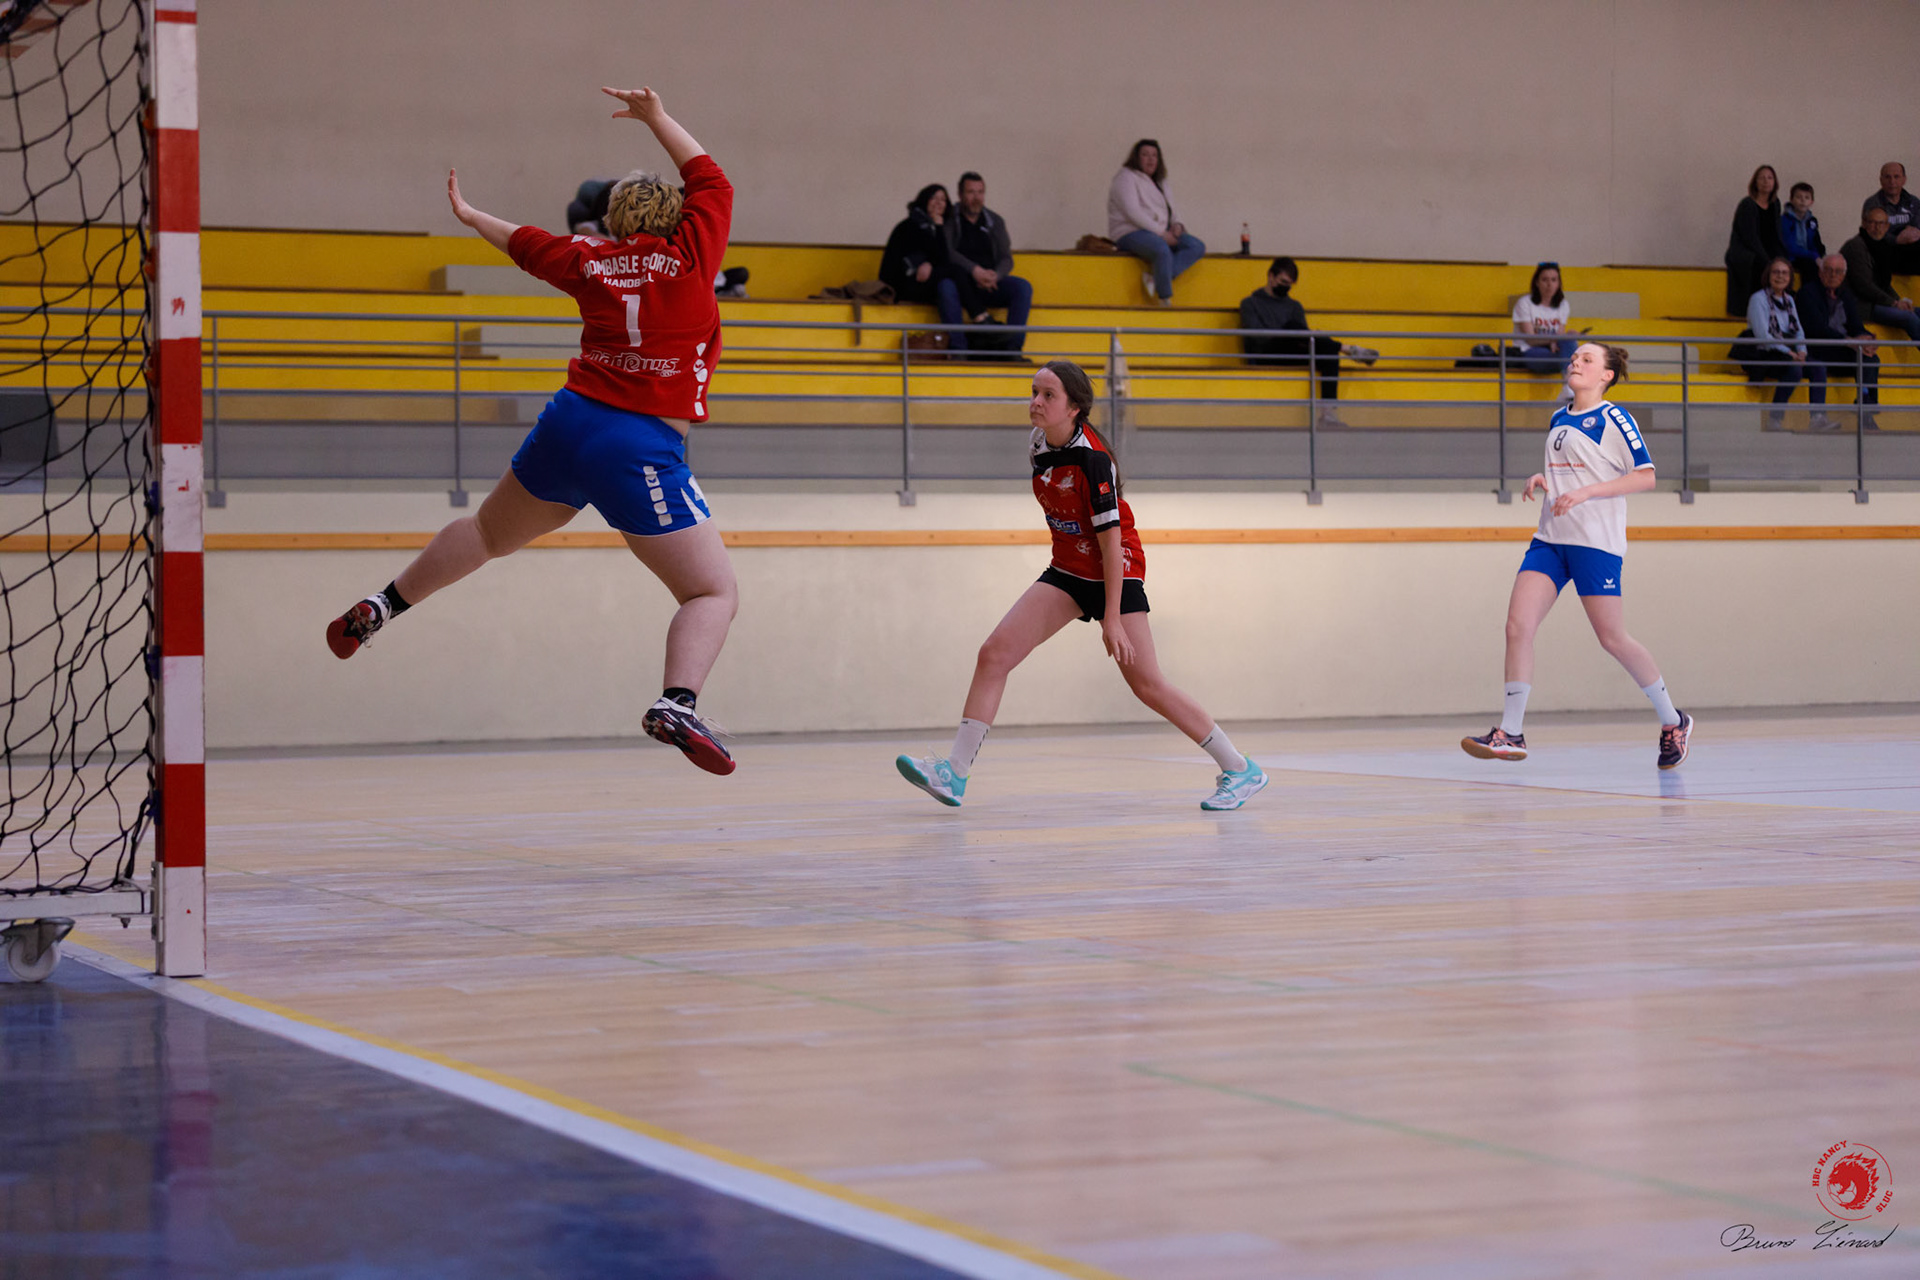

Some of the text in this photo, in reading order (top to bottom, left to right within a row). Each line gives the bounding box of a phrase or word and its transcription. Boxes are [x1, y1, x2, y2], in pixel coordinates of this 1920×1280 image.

[583, 253, 680, 279] DOMBASLE SORTS
[603, 272, 654, 288] HANDBLL
[622, 294, 642, 347] 1
[1554, 429, 1568, 451] 8
[1040, 466, 1053, 487] 4
